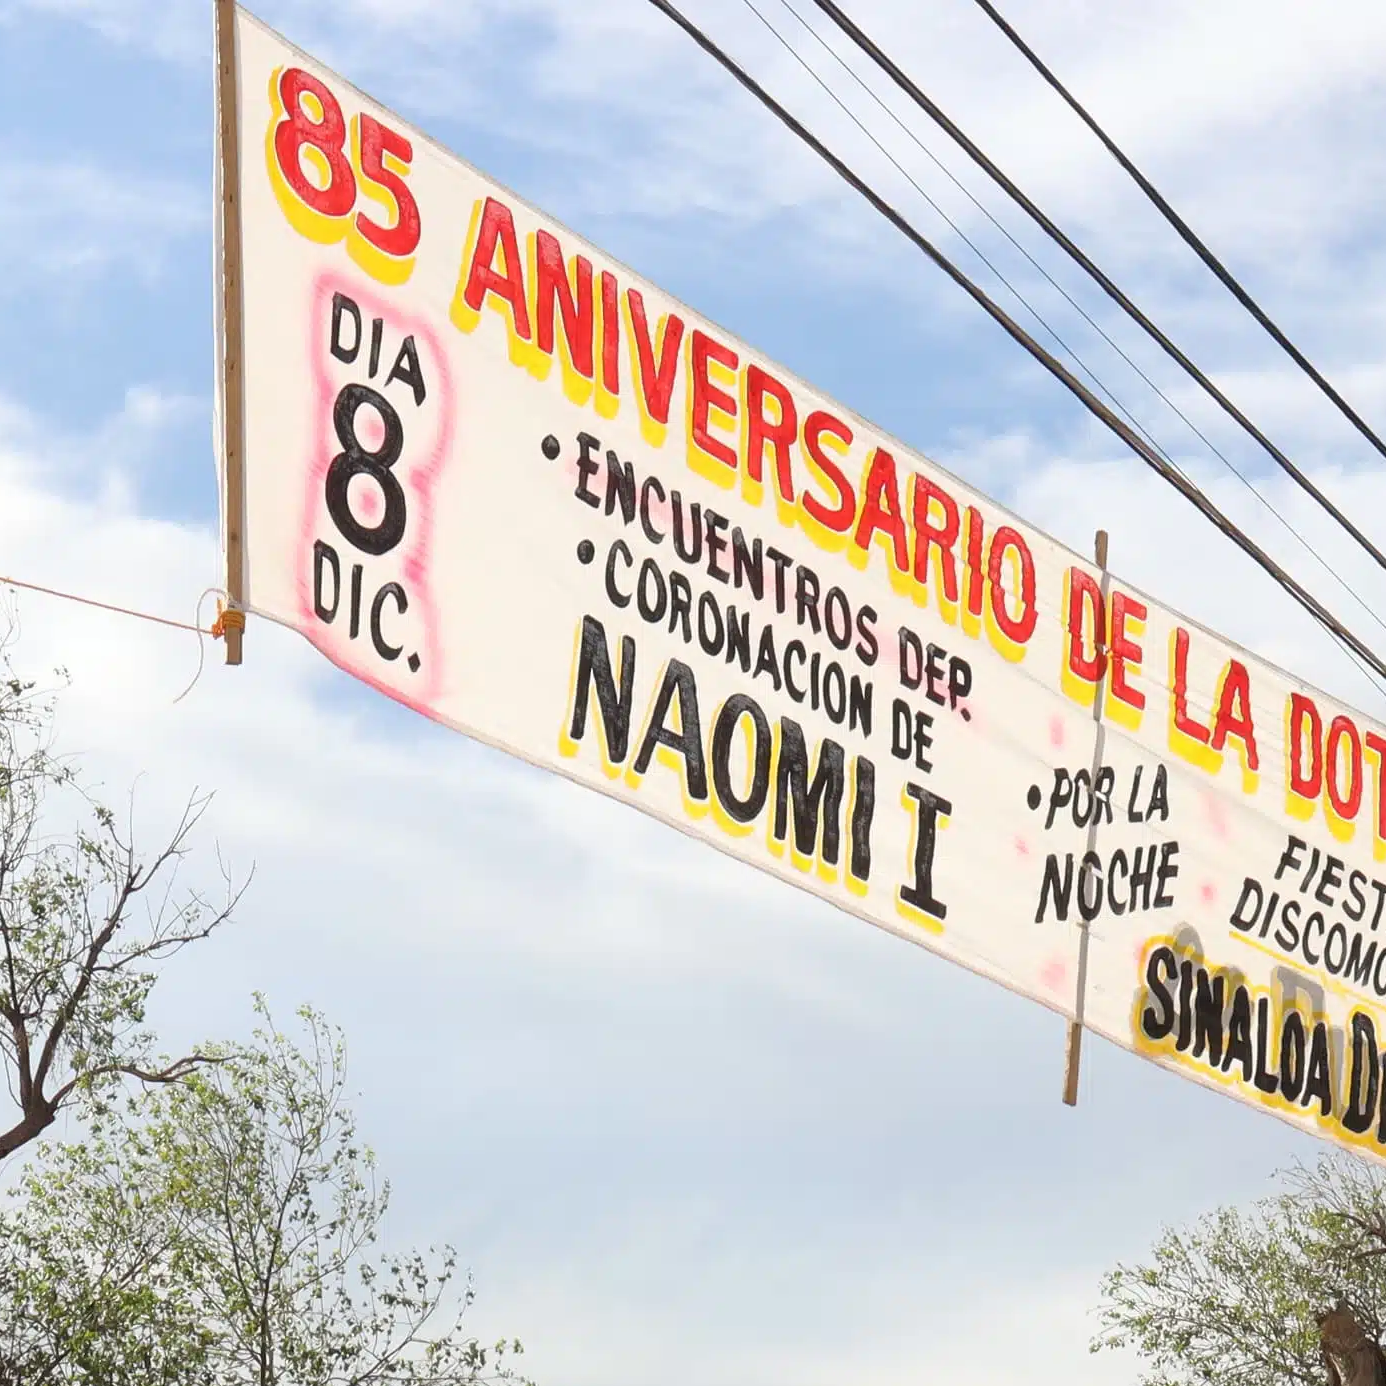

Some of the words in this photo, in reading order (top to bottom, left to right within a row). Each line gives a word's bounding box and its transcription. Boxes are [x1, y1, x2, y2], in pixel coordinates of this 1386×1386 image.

[274, 67, 421, 257] 85
[464, 196, 1037, 645] ANIVERSARIO
[1067, 567, 1147, 711] DE
[1174, 627, 1259, 773] LA
[331, 291, 427, 407] DIA
[325, 384, 407, 556] 8
[313, 540, 420, 673] DIC.
[574, 431, 879, 666] ENCUENTROS
[899, 626, 974, 722] DEP.
[605, 544, 874, 739] CORONACION
[892, 699, 933, 773] DE
[569, 615, 877, 880] NAOMI
[900, 782, 953, 920] I
[1045, 766, 1112, 830] POR
[1128, 762, 1170, 823] LA
[1035, 841, 1180, 923] NOCHE
[1143, 946, 1332, 1117] SINALOA
